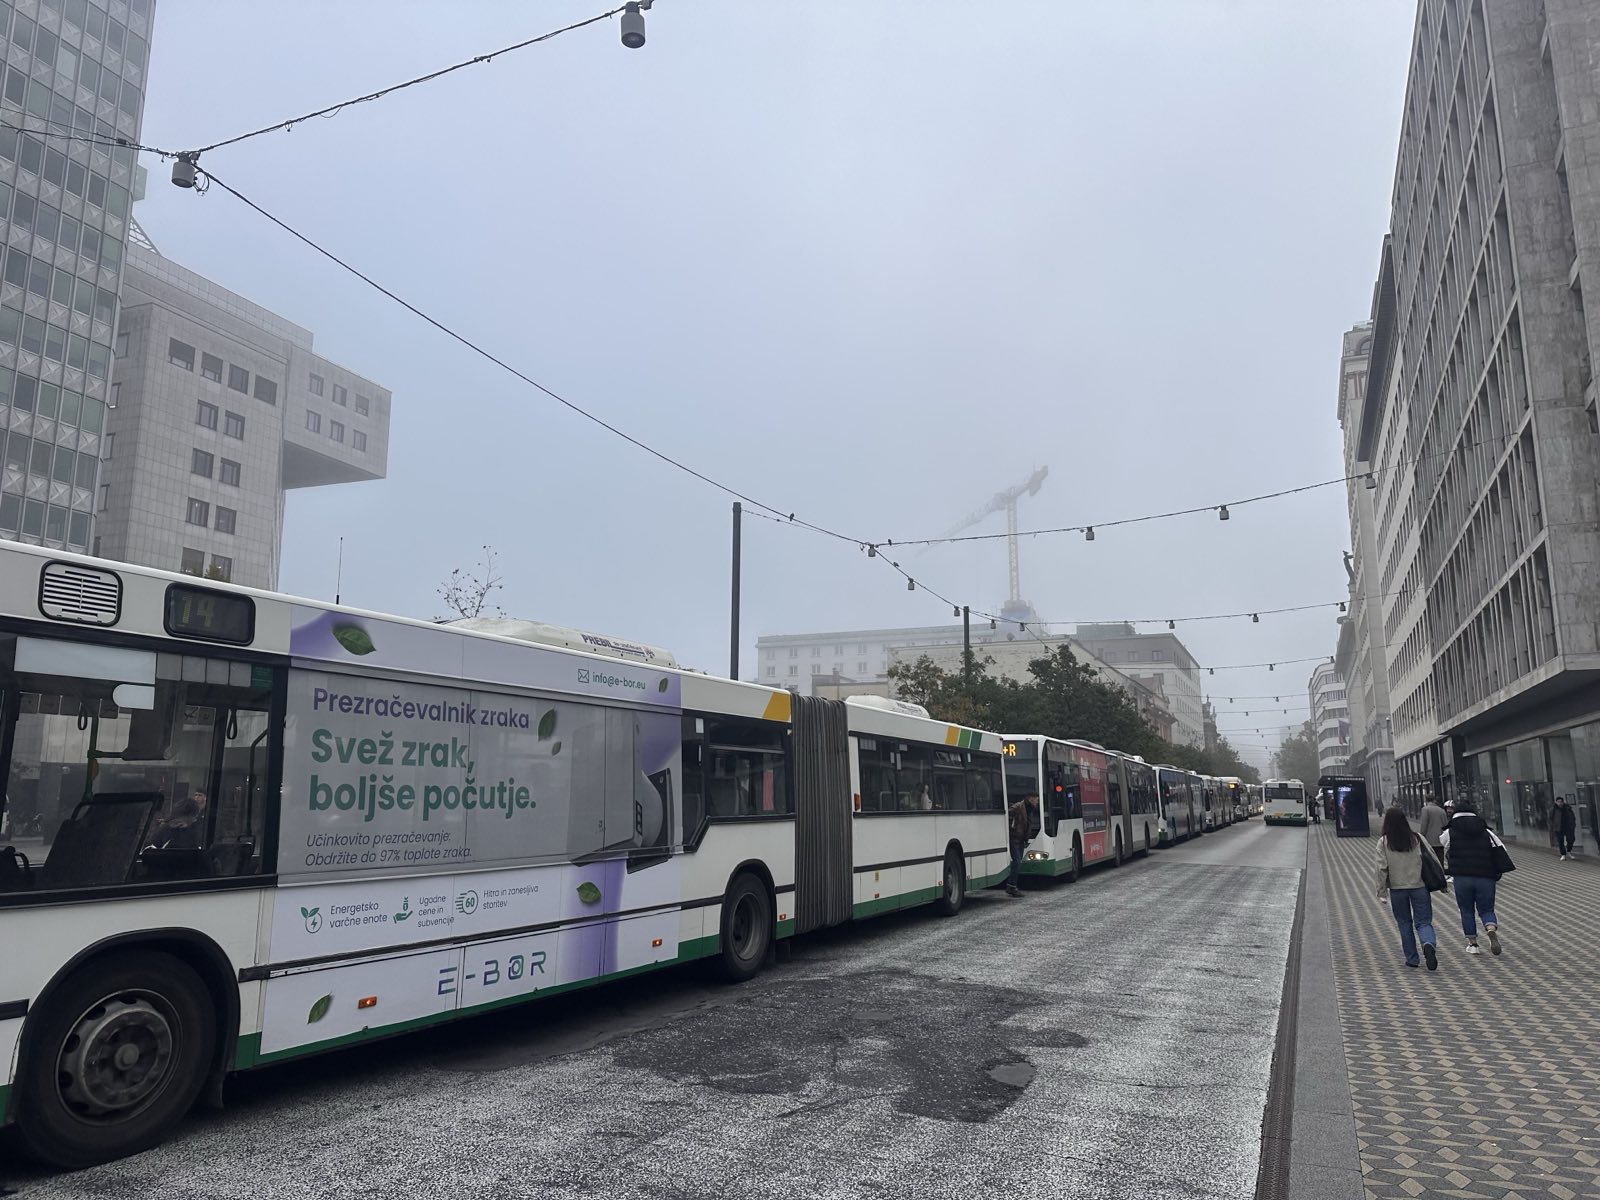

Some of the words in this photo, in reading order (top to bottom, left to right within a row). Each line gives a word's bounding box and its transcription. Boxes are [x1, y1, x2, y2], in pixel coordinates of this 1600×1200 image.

[181, 596, 215, 628] 14
[592, 672, 646, 690] info@e-bor.eu
[313, 687, 476, 725] Prezračevalnik
[480, 708, 529, 728] zraka
[311, 728, 394, 764] Svež
[401, 736, 475, 773] zrak,
[309, 774, 415, 822] boljše
[422, 777, 536, 821] počutje.
[306, 833, 370, 847] Učinkovito
[305, 849, 357, 866] Obdržite
[360, 851, 376, 863] do
[380, 849, 400, 862] 97%
[403, 848, 440, 863] toplote
[443, 846, 472, 859] zraka.
[419, 895, 446, 907] Ugodne
[483, 889, 500, 898] Hitra
[330, 902, 379, 915] Energetsko
[465, 897, 475, 908] 60
[418, 908, 436, 916] cene
[330, 916, 360, 928] varčne
[363, 913, 388, 924] enote
[438, 951, 546, 995] E-BOR
